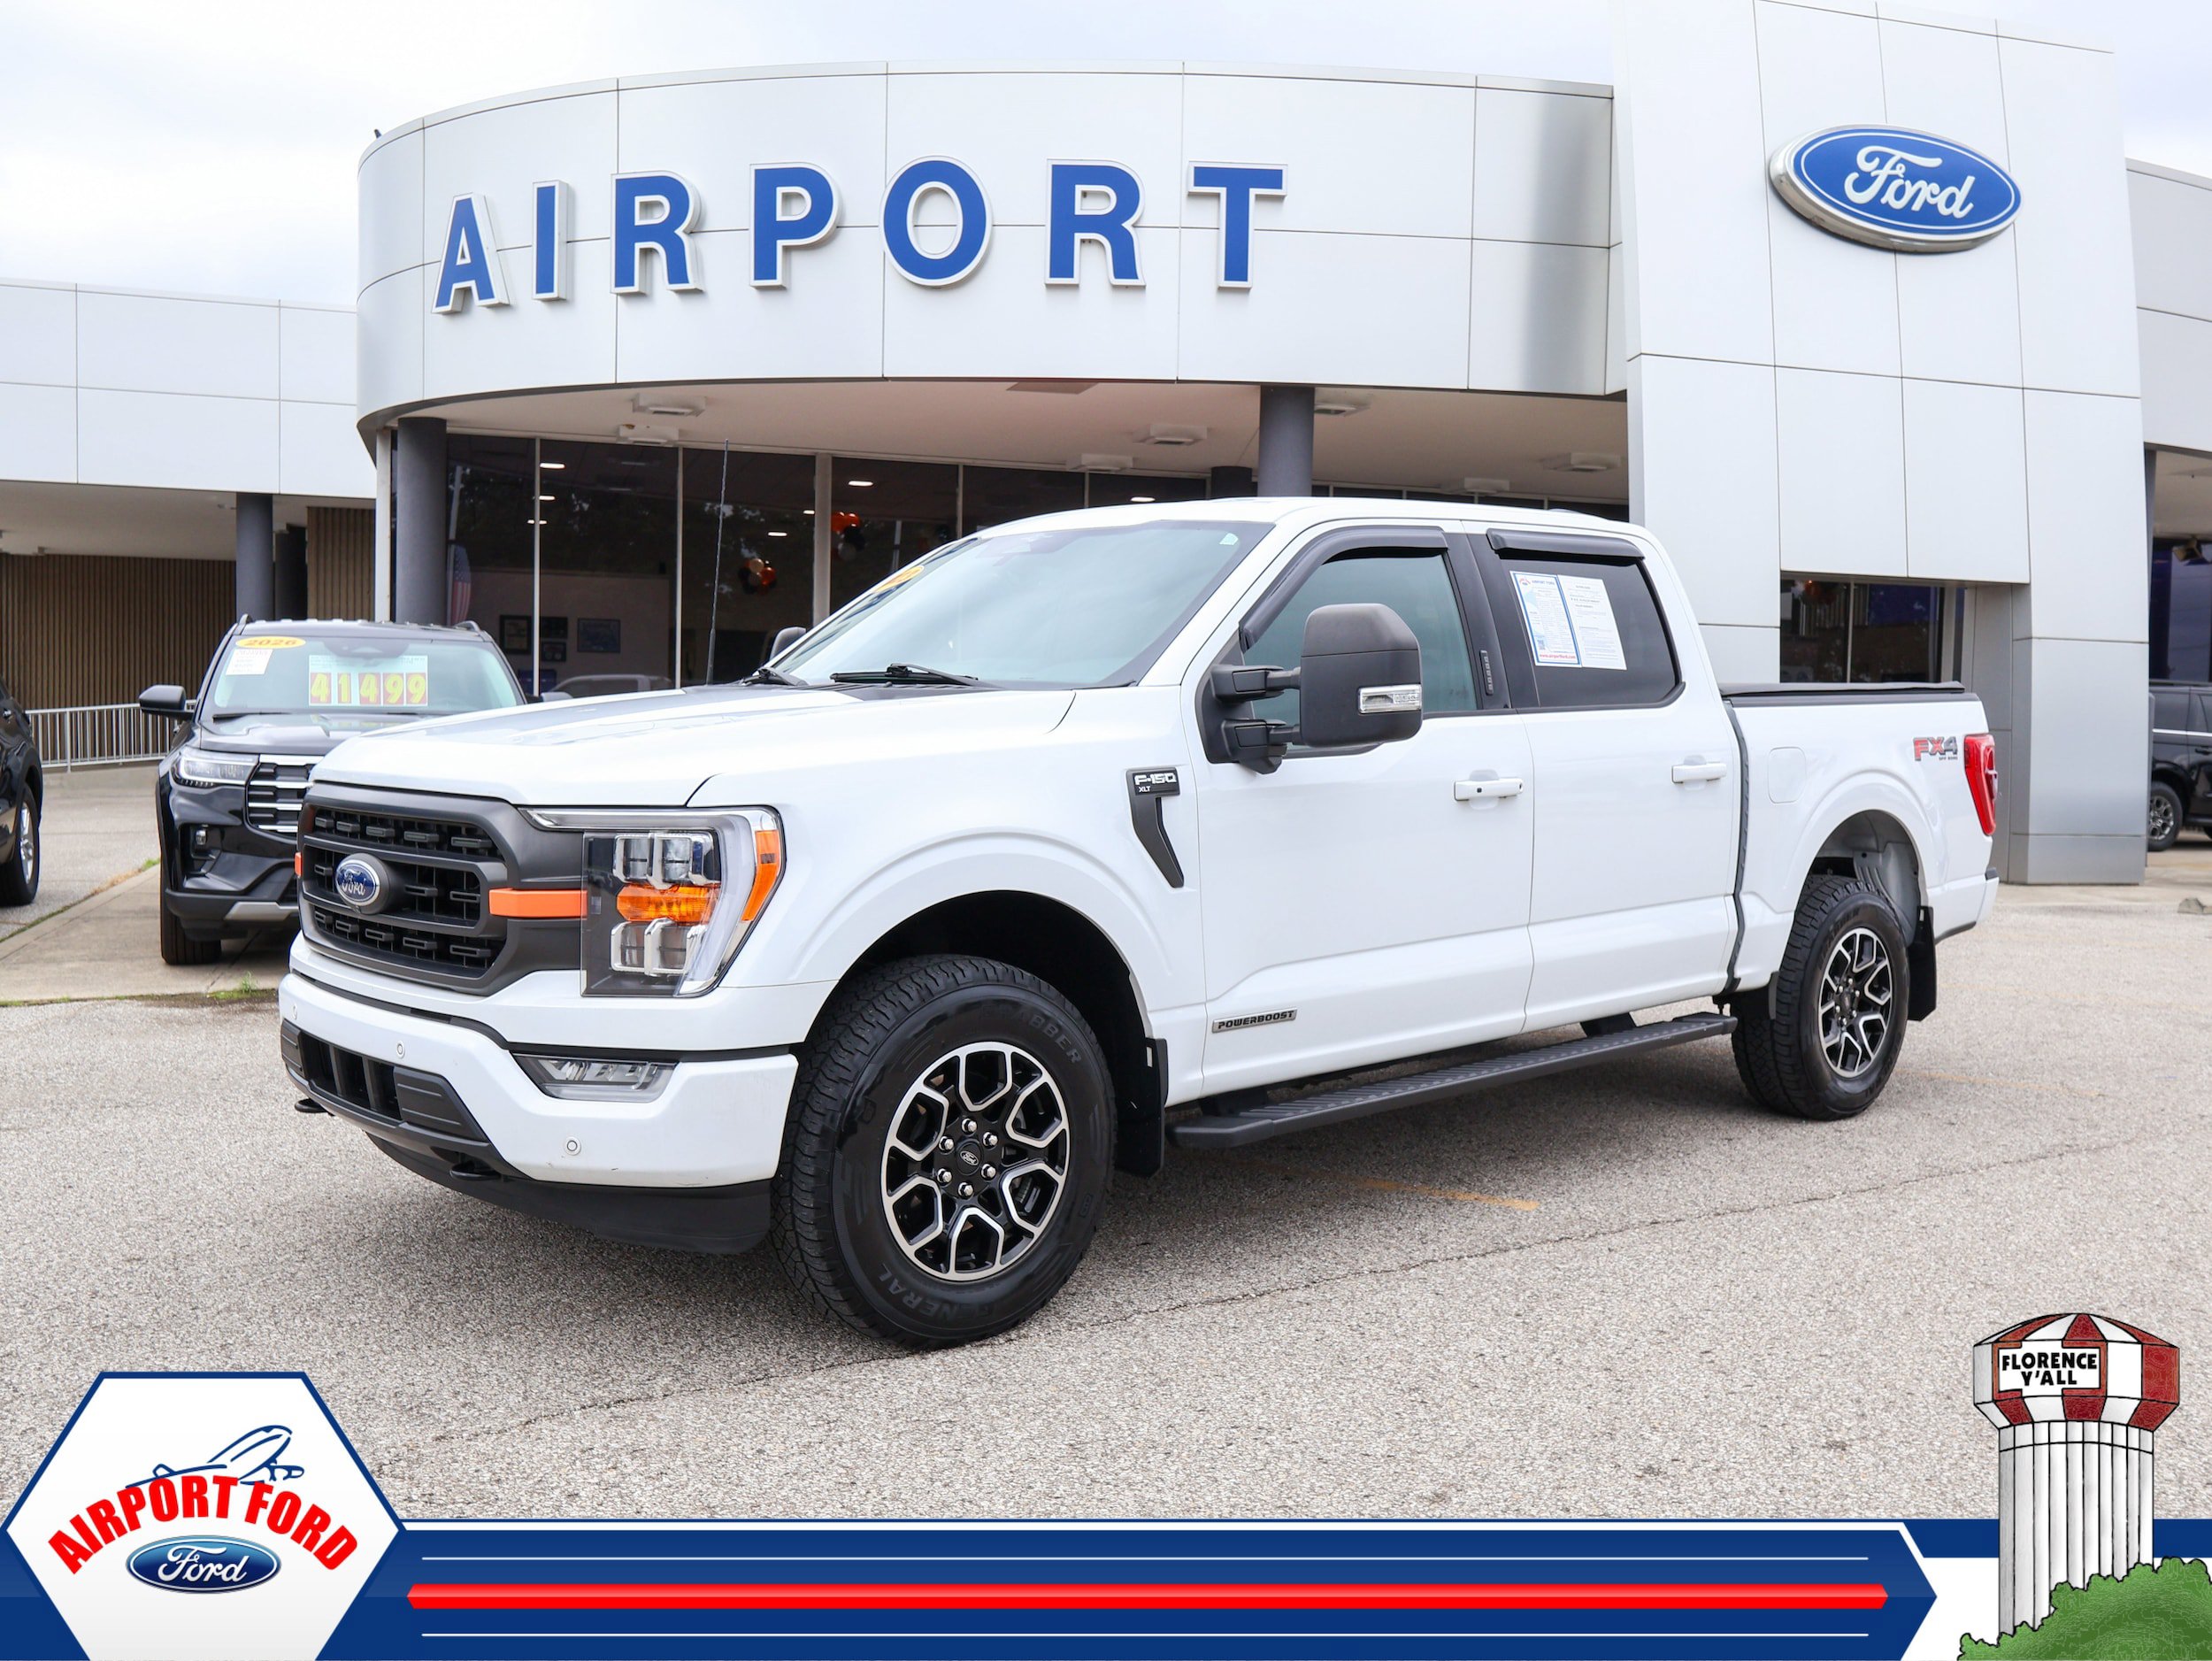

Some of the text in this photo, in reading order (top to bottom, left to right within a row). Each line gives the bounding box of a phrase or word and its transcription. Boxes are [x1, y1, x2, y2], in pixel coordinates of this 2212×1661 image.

[1844, 145, 1976, 219] Ford
[432, 155, 1288, 314] AIRPORT
[243, 638, 297, 647] 2026
[310, 673, 426, 704] 41499
[1913, 736, 1958, 761] FX4
[1133, 773, 1178, 786] F-150
[341, 868, 366, 896] Ford
[1217, 1010, 1294, 1029] POWERBOOST
